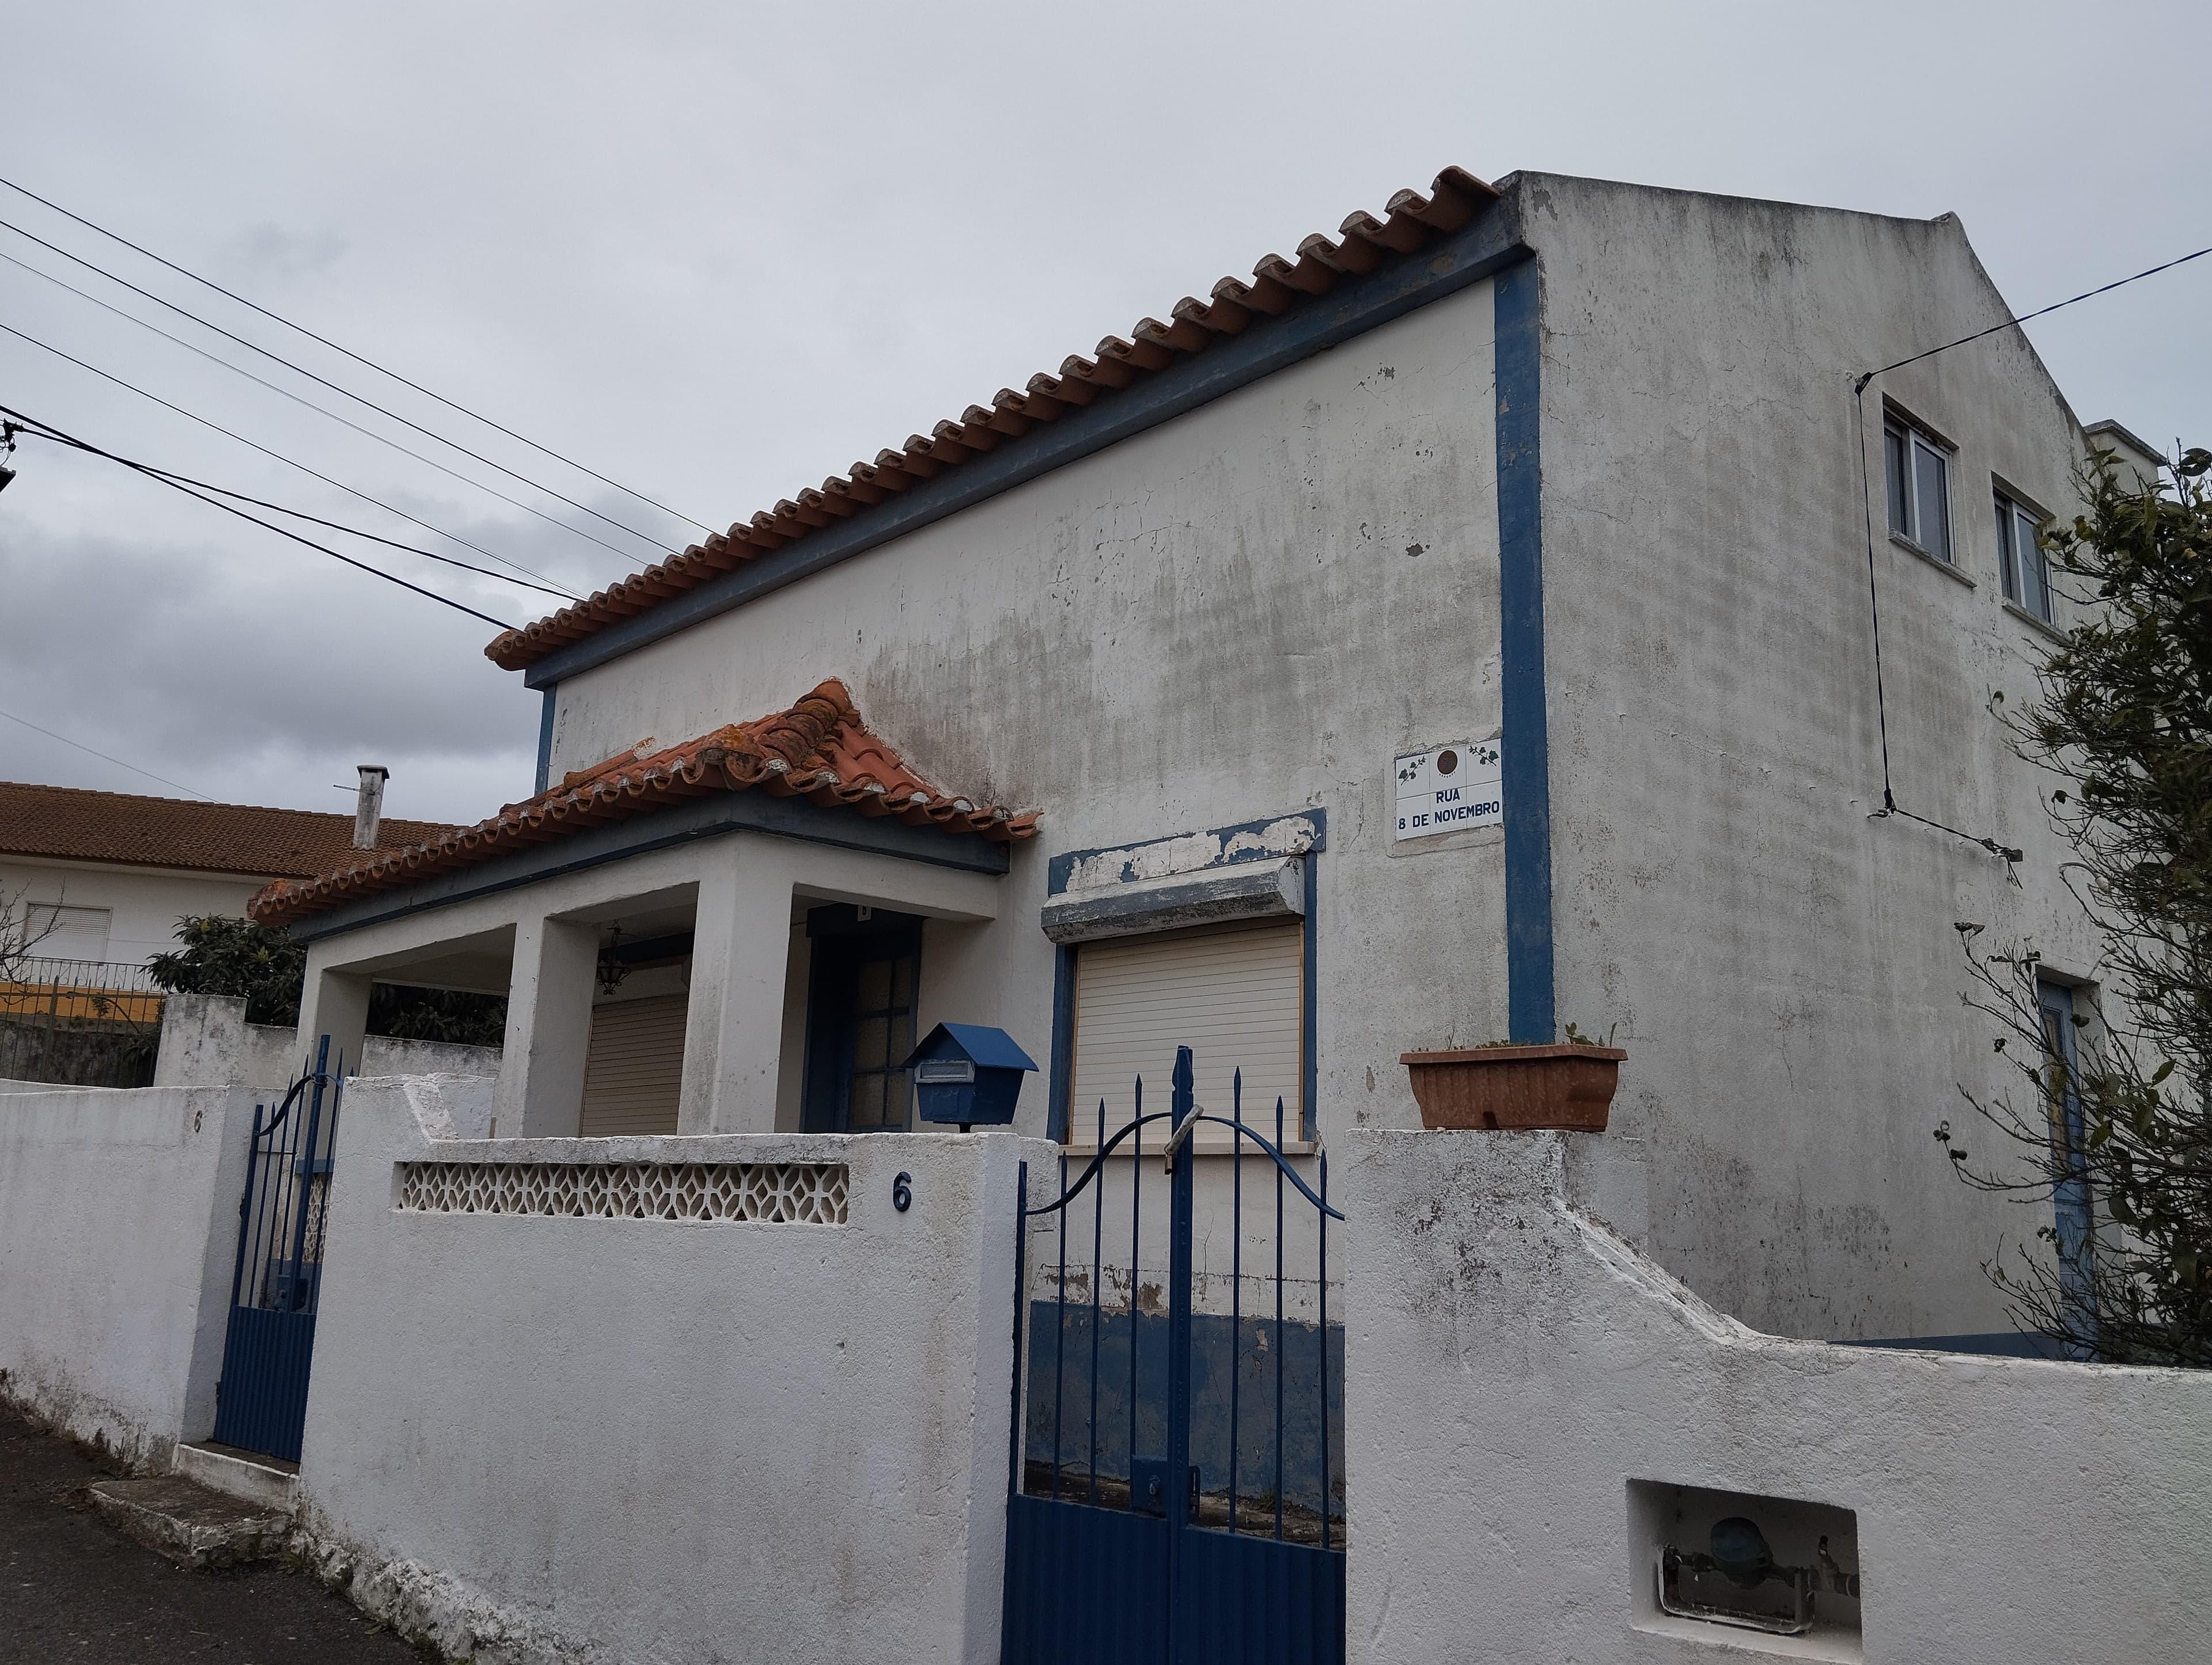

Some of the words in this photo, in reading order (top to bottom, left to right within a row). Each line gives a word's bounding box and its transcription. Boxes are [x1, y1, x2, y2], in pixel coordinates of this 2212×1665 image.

[1436, 788, 1460, 803] RUA
[1398, 818, 1406, 830] 8
[1412, 814, 1429, 828] DE
[1434, 801, 1499, 824] NOVEMBRO
[194, 1110, 203, 1133] 6
[892, 1171, 912, 1213] 6
